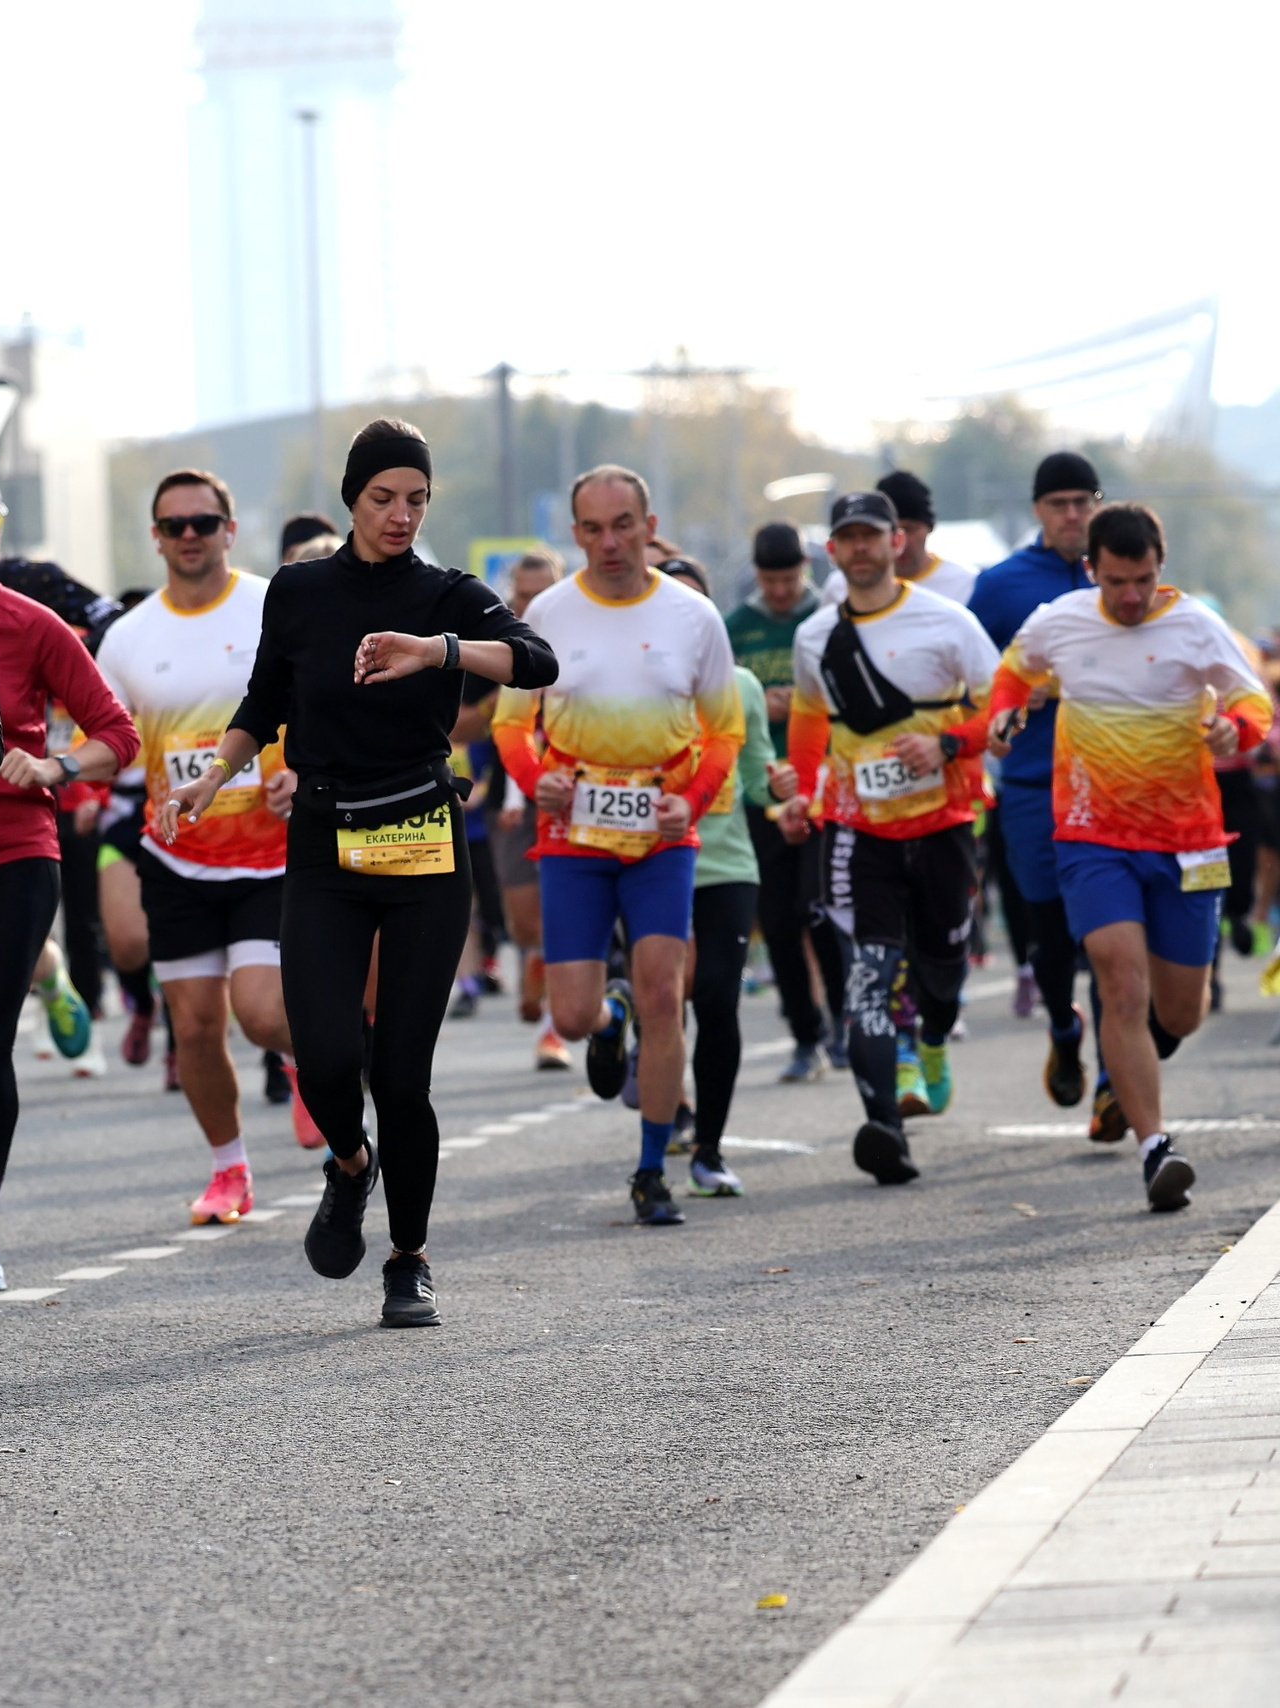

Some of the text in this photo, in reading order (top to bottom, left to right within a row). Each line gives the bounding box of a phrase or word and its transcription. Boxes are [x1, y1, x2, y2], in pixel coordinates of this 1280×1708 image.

[862, 760, 938, 789] 153
[587, 788, 651, 818] 1258
[366, 832, 426, 844] ЕКАТЕРИНА
